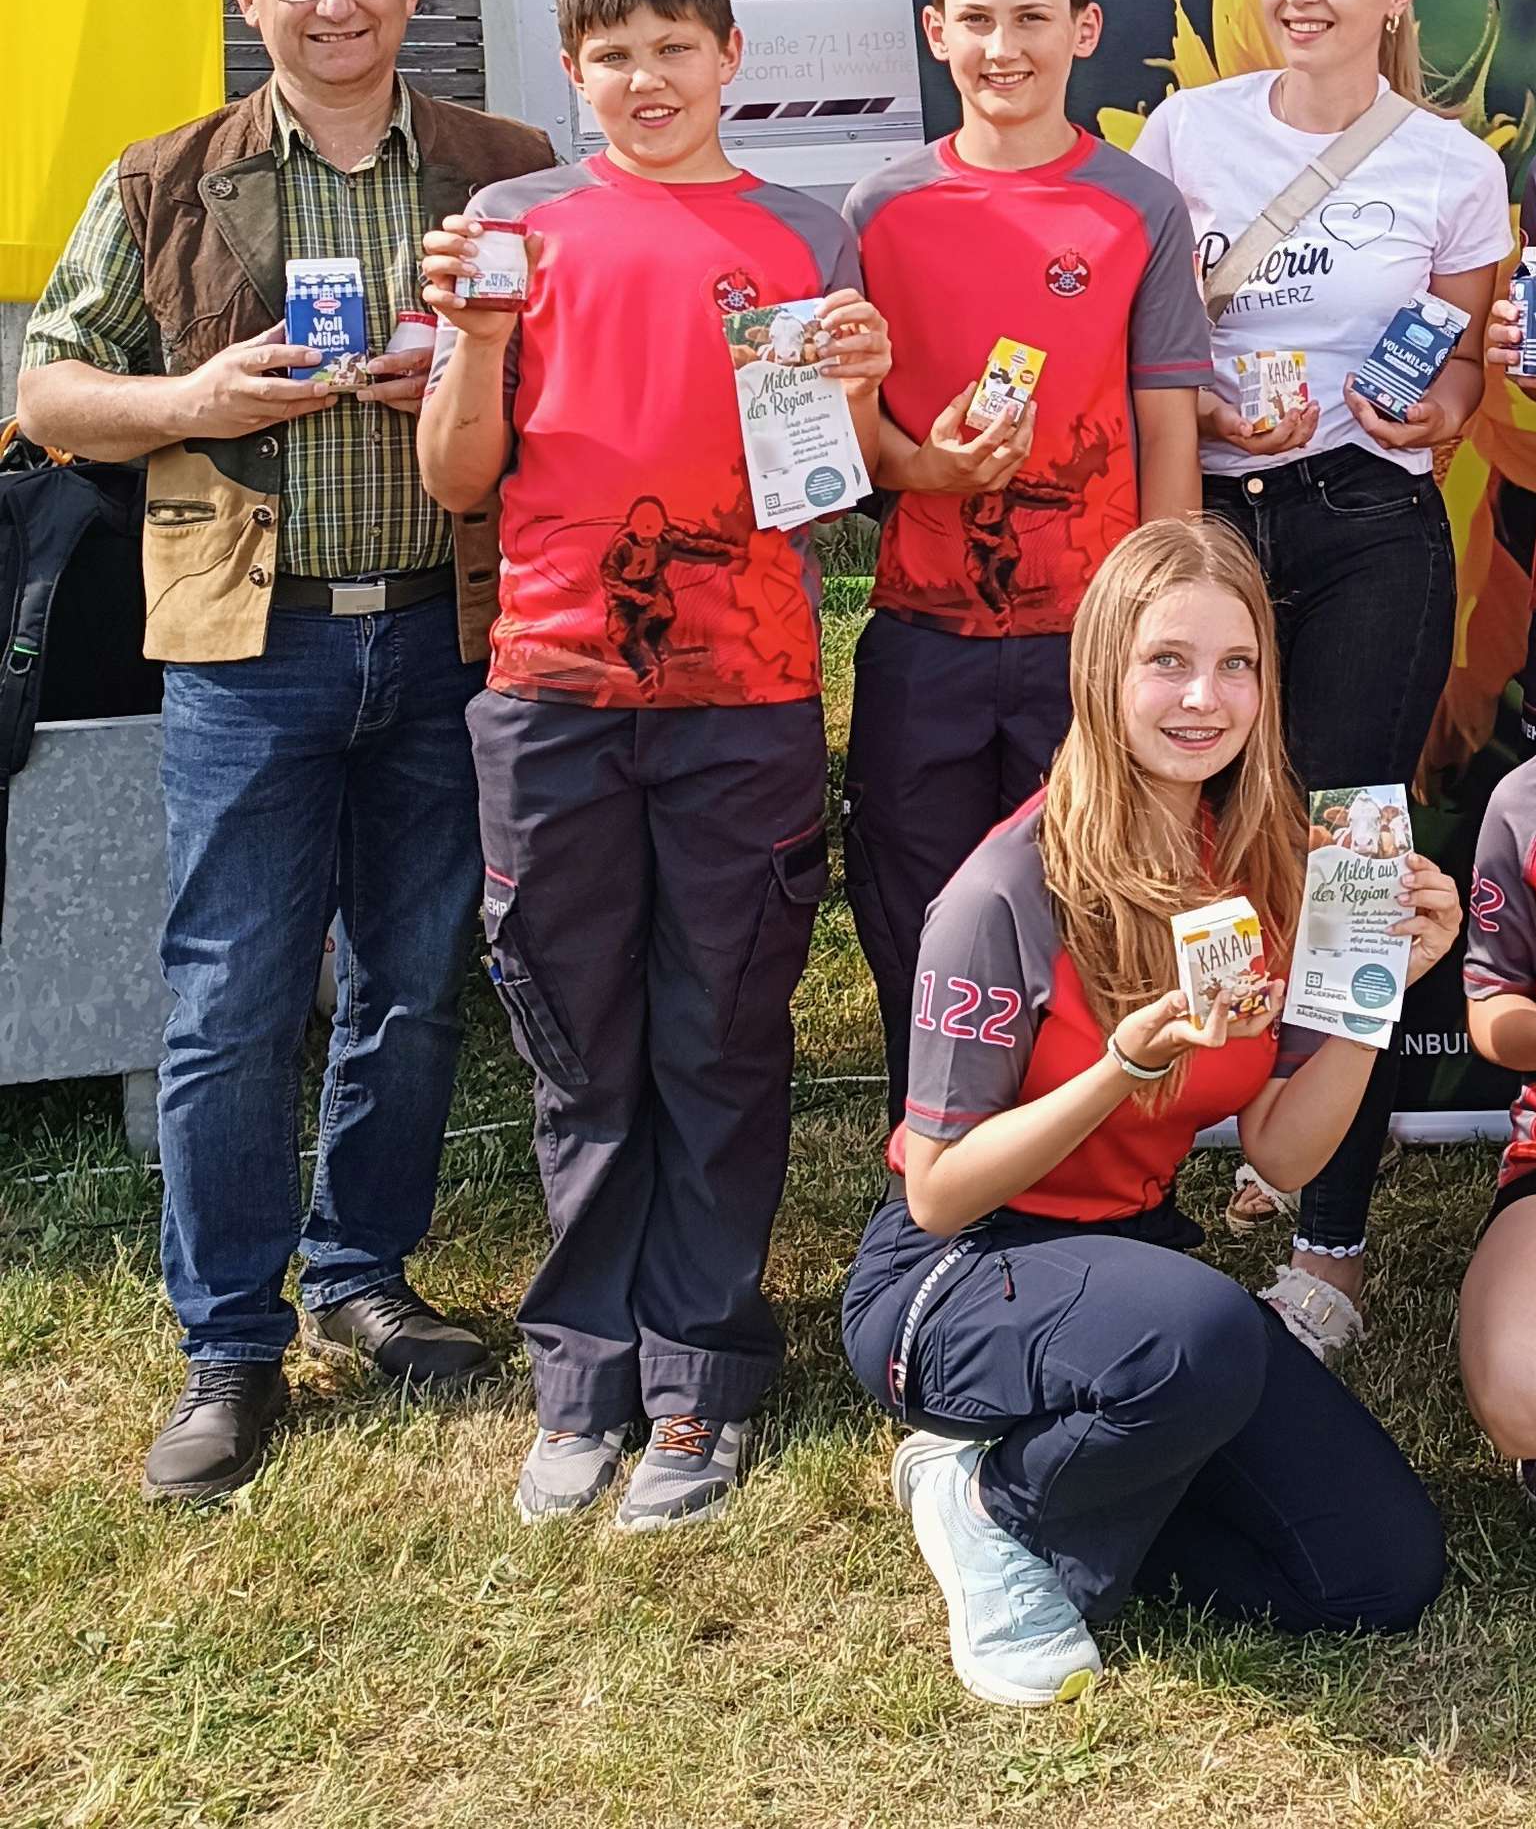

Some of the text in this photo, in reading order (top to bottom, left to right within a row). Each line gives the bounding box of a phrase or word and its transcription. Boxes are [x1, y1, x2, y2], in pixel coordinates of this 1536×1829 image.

[808, 33, 838, 55] 7/1
[858, 31, 907, 53] 4193
[1259, 285, 1314, 309] HERZ
[313, 316, 343, 332] Voll
[308, 331, 350, 347] Milch
[1382, 338, 1435, 376] VOLLMILCH
[757, 366, 798, 400] Milch
[1267, 359, 1301, 385] KAKAO
[748, 397, 768, 420] der
[769, 390, 814, 416] Region
[1326, 858, 1374, 885] Milch
[1311, 882, 1390, 906] der Region
[1197, 930, 1254, 972] KAKAO
[914, 970, 1022, 1048] 122
